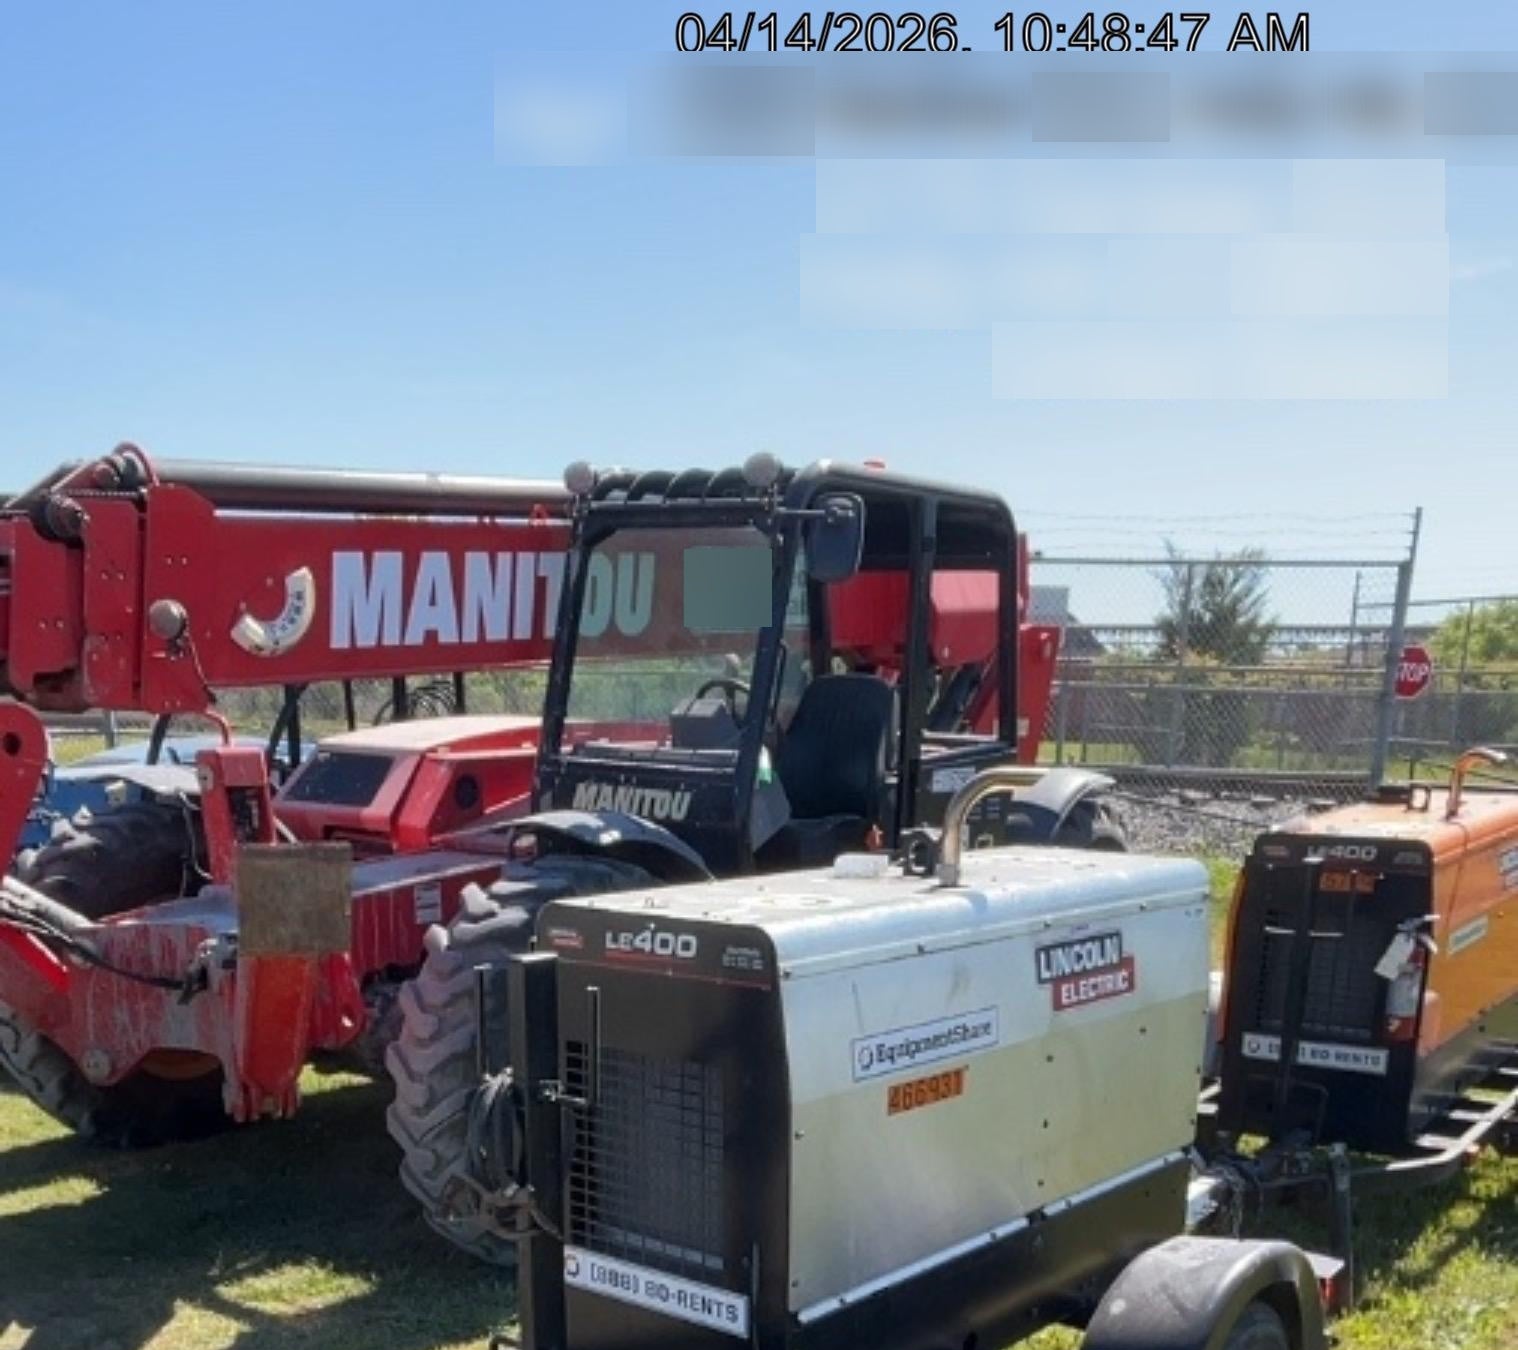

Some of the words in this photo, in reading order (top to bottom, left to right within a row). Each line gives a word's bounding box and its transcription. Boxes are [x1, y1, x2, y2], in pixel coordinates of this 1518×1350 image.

[330, 551, 655, 648] MANITOU
[572, 782, 692, 821] MANITOU
[1040, 936, 1119, 979] LINCOLN
[1061, 968, 1129, 1005] ELECTRIC
[875, 1022, 992, 1064] EquipmentShare
[888, 1070, 962, 1114] 466931
